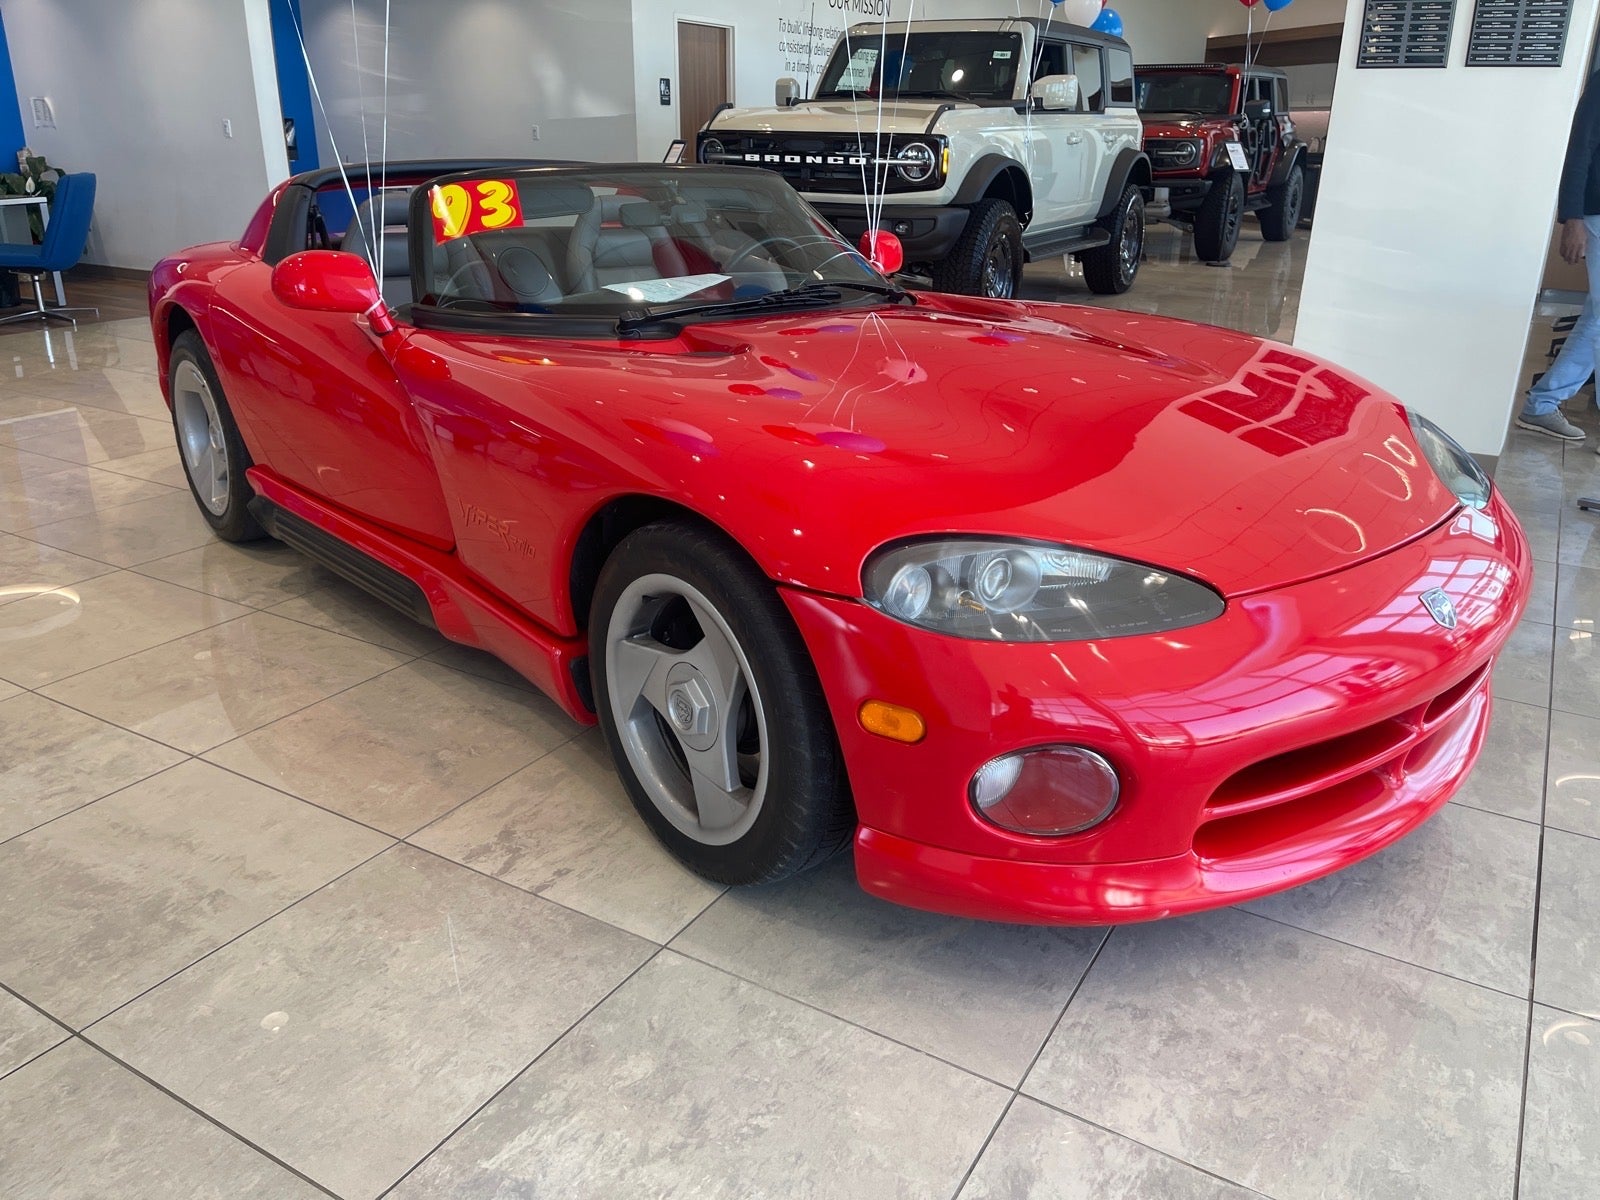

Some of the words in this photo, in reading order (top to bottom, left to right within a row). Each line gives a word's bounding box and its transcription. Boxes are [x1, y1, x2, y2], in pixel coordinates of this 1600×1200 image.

[852, 0, 891, 17] MISSION
[779, 17, 786, 32] To
[803, 22, 823, 40] lifeong
[779, 40, 813, 55] consistent
[797, 59, 816, 76] timey,
[745, 154, 867, 165] BRONCO
[432, 180, 517, 238] 93
